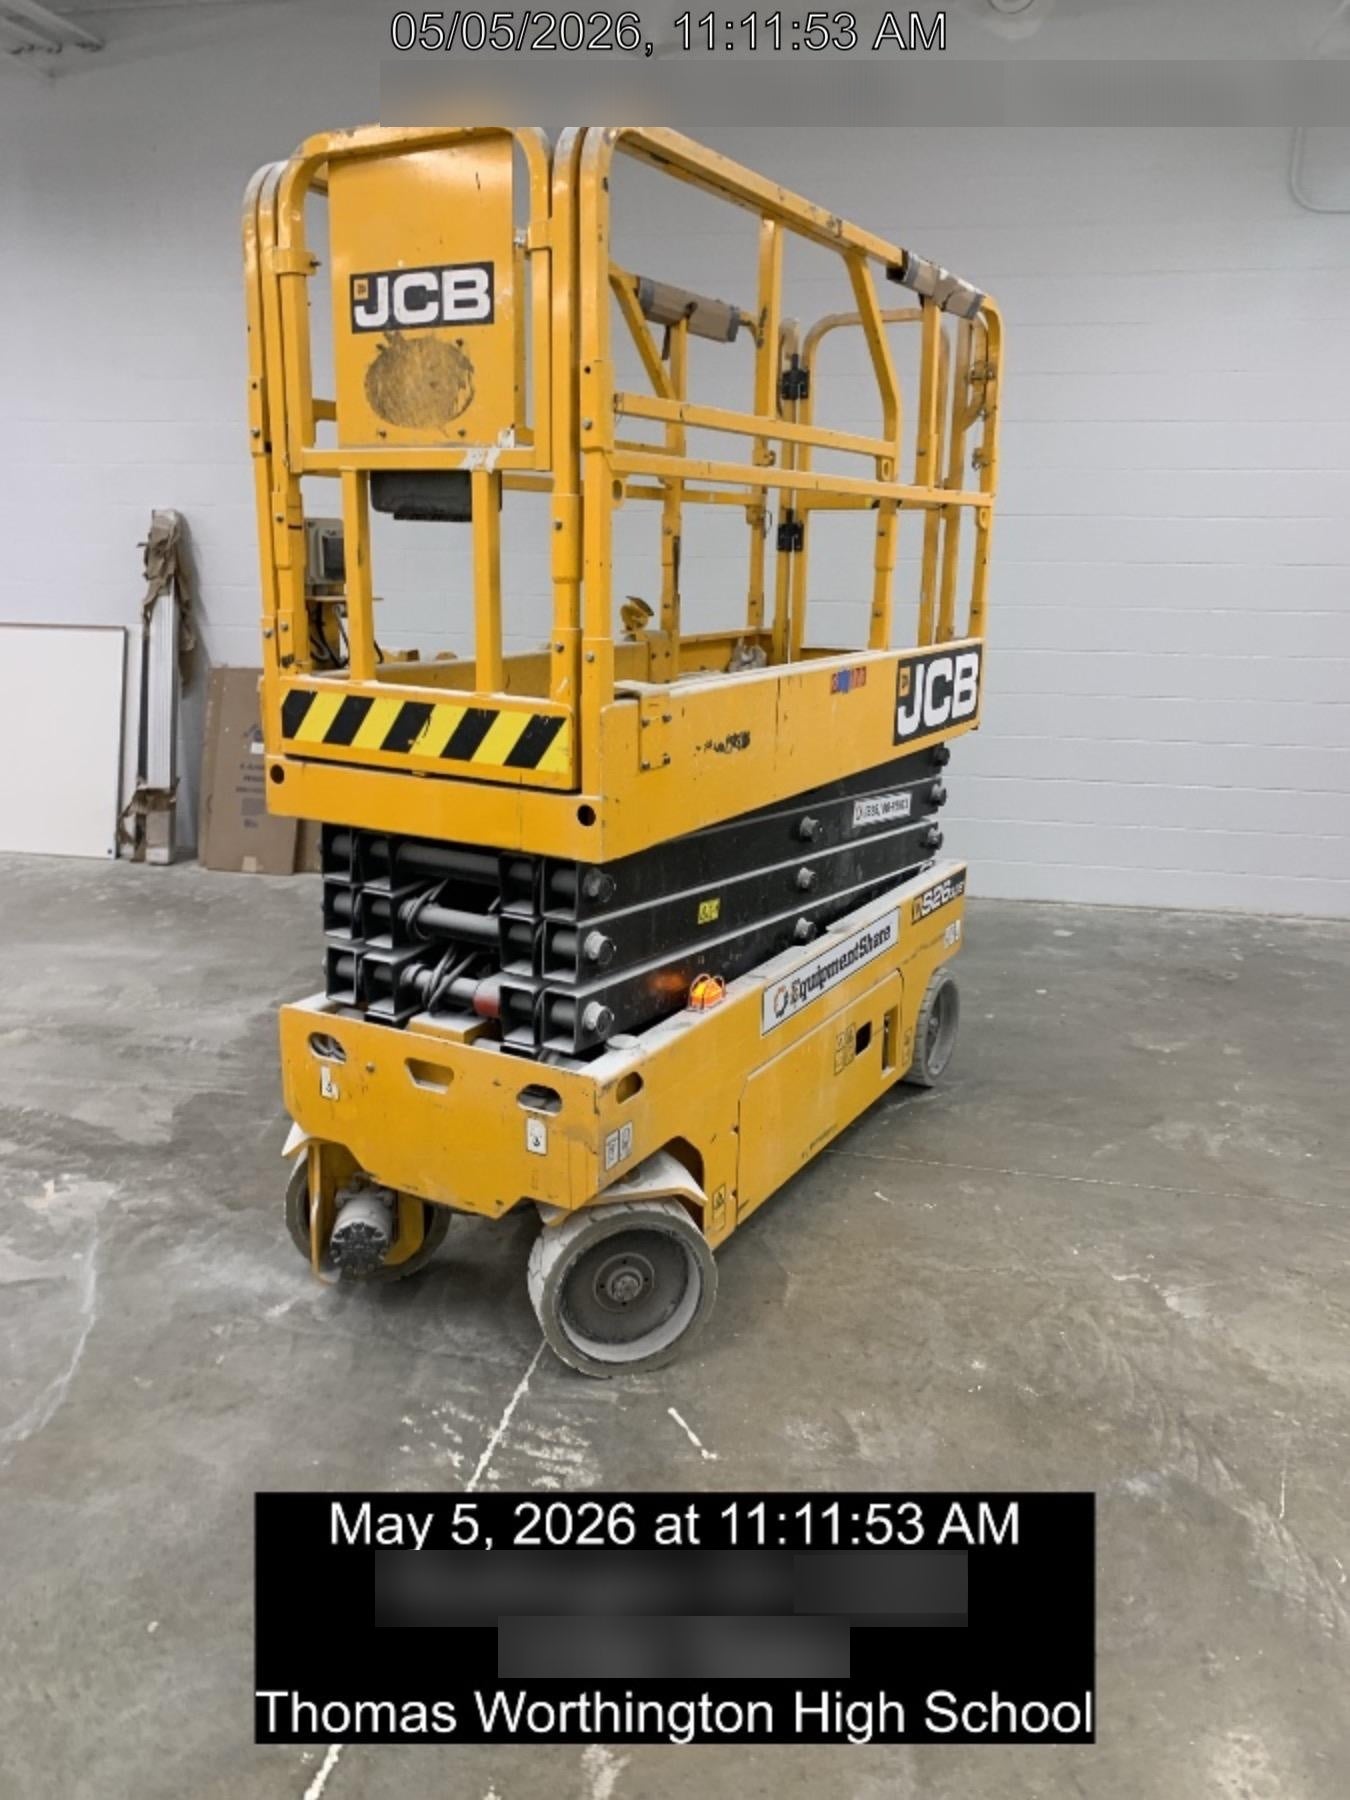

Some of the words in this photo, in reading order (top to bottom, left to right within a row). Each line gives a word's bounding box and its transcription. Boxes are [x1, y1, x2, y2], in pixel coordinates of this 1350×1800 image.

[354, 267, 491, 328] JCB
[897, 652, 979, 737] JCB
[790, 925, 891, 1006] EquipmentShare
